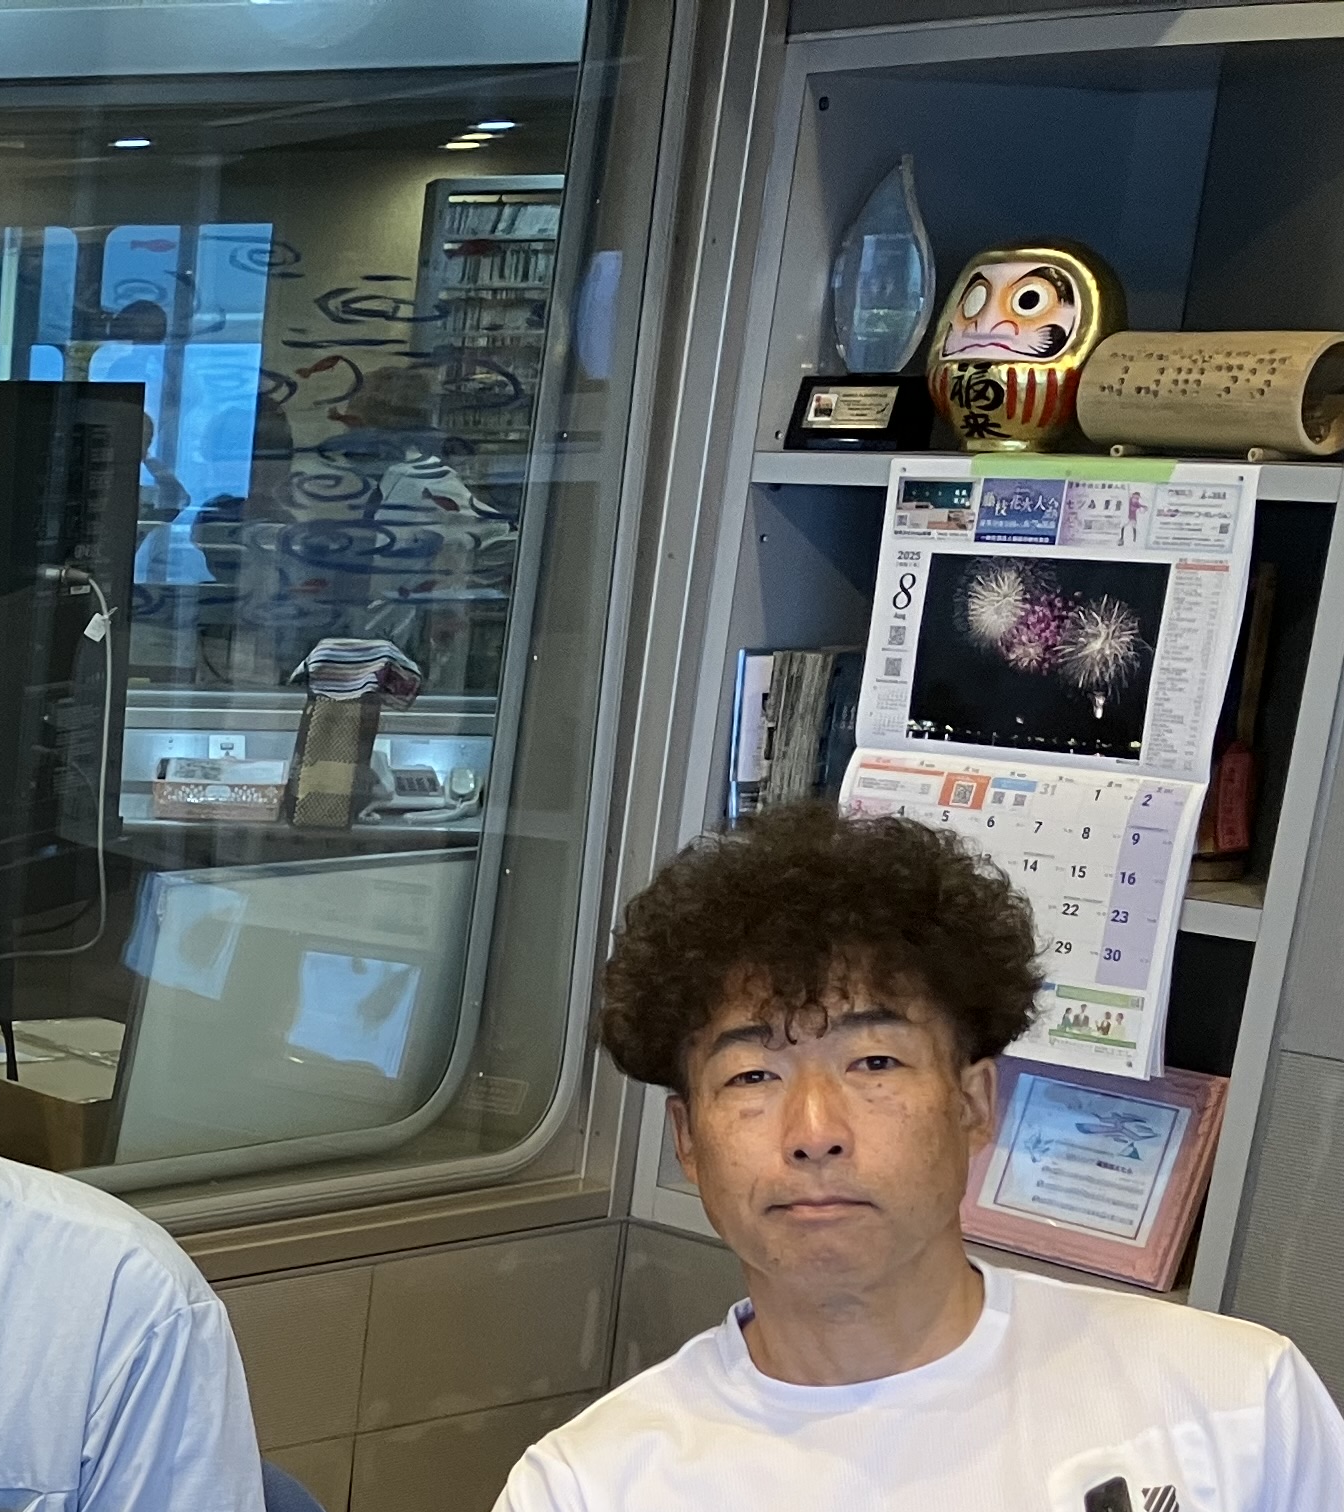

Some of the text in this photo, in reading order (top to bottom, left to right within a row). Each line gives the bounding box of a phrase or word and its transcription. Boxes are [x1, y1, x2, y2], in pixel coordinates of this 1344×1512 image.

[897, 551, 921, 560] 2025
[893, 573, 916, 610] 8
[1094, 789, 1102, 801] 1
[1141, 794, 1153, 807] 2
[941, 810, 950, 822] 5
[987, 816, 995, 828] 6
[1034, 821, 1043, 834] 7
[1081, 827, 1091, 840] 8
[1131, 833, 1140, 846] 9
[1022, 859, 1136, 885] 14 15 16
[1062, 904, 1129, 923] 22 23
[1055, 941, 1121, 962] 29 30
